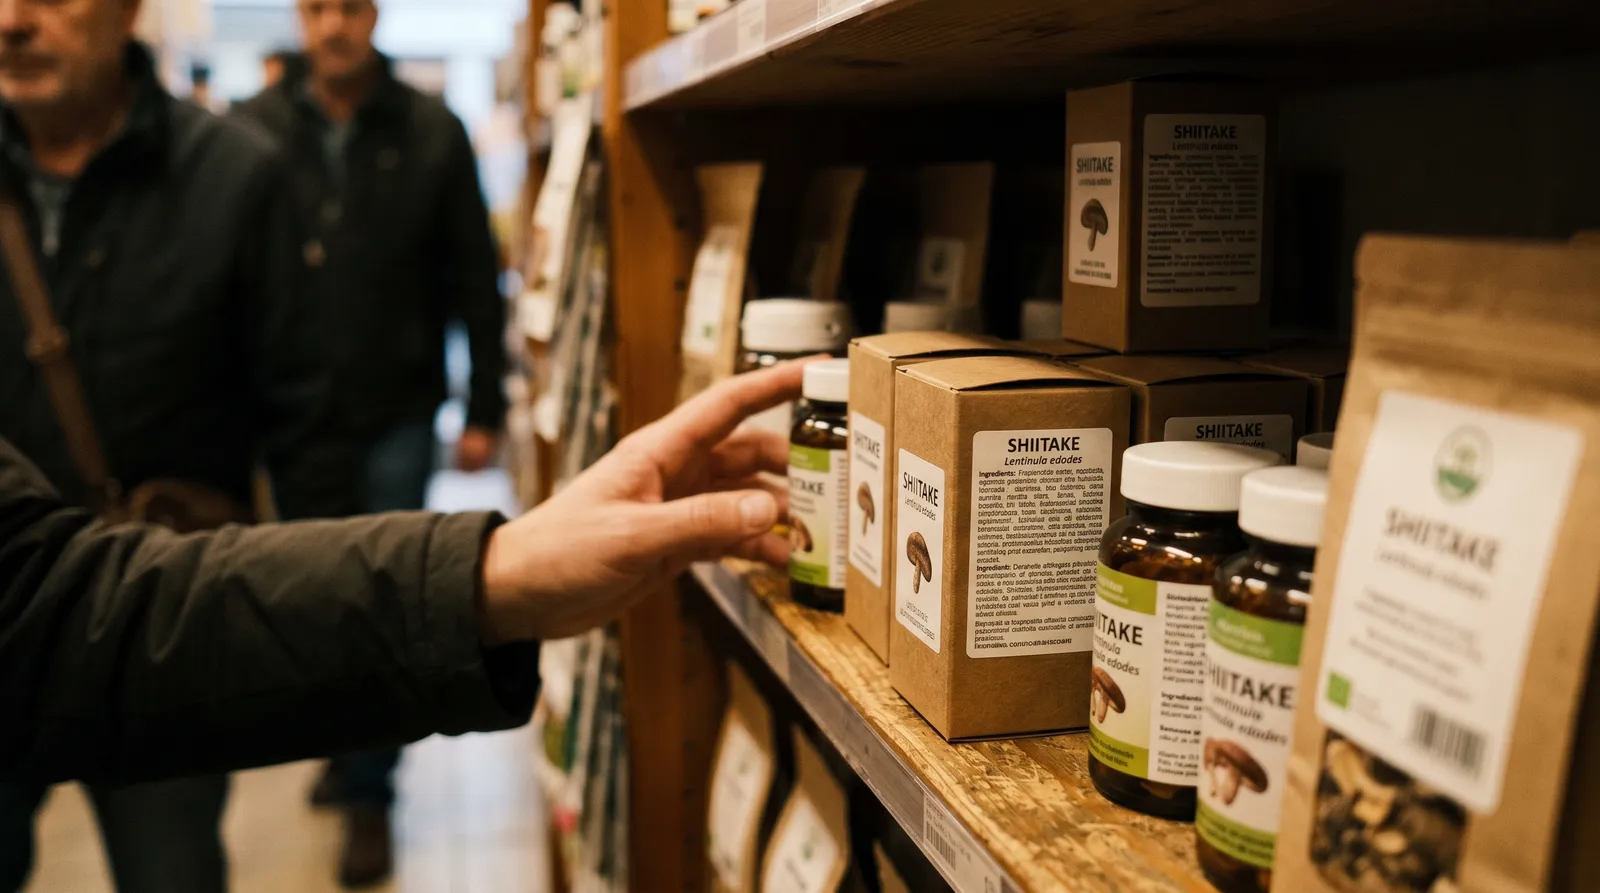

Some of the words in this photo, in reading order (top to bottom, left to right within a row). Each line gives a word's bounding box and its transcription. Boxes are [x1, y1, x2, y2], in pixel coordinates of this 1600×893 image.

[1174, 125, 1238, 139] SHIITAKE
[1076, 157, 1113, 173] SHIITAKE
[1196, 423, 1262, 438] SHIITAKE
[854, 430, 880, 459] SHIITAKE
[1008, 437, 1080, 452] SHIITAKE
[1005, 456, 1047, 466] Lentinula
[1050, 455, 1082, 464] edodes
[979, 470, 1015, 478] Ingredients:
[903, 472, 939, 507] SHIITAKE
[1386, 507, 1499, 573] SHIITAKE
[1107, 657, 1140, 676] edodes
